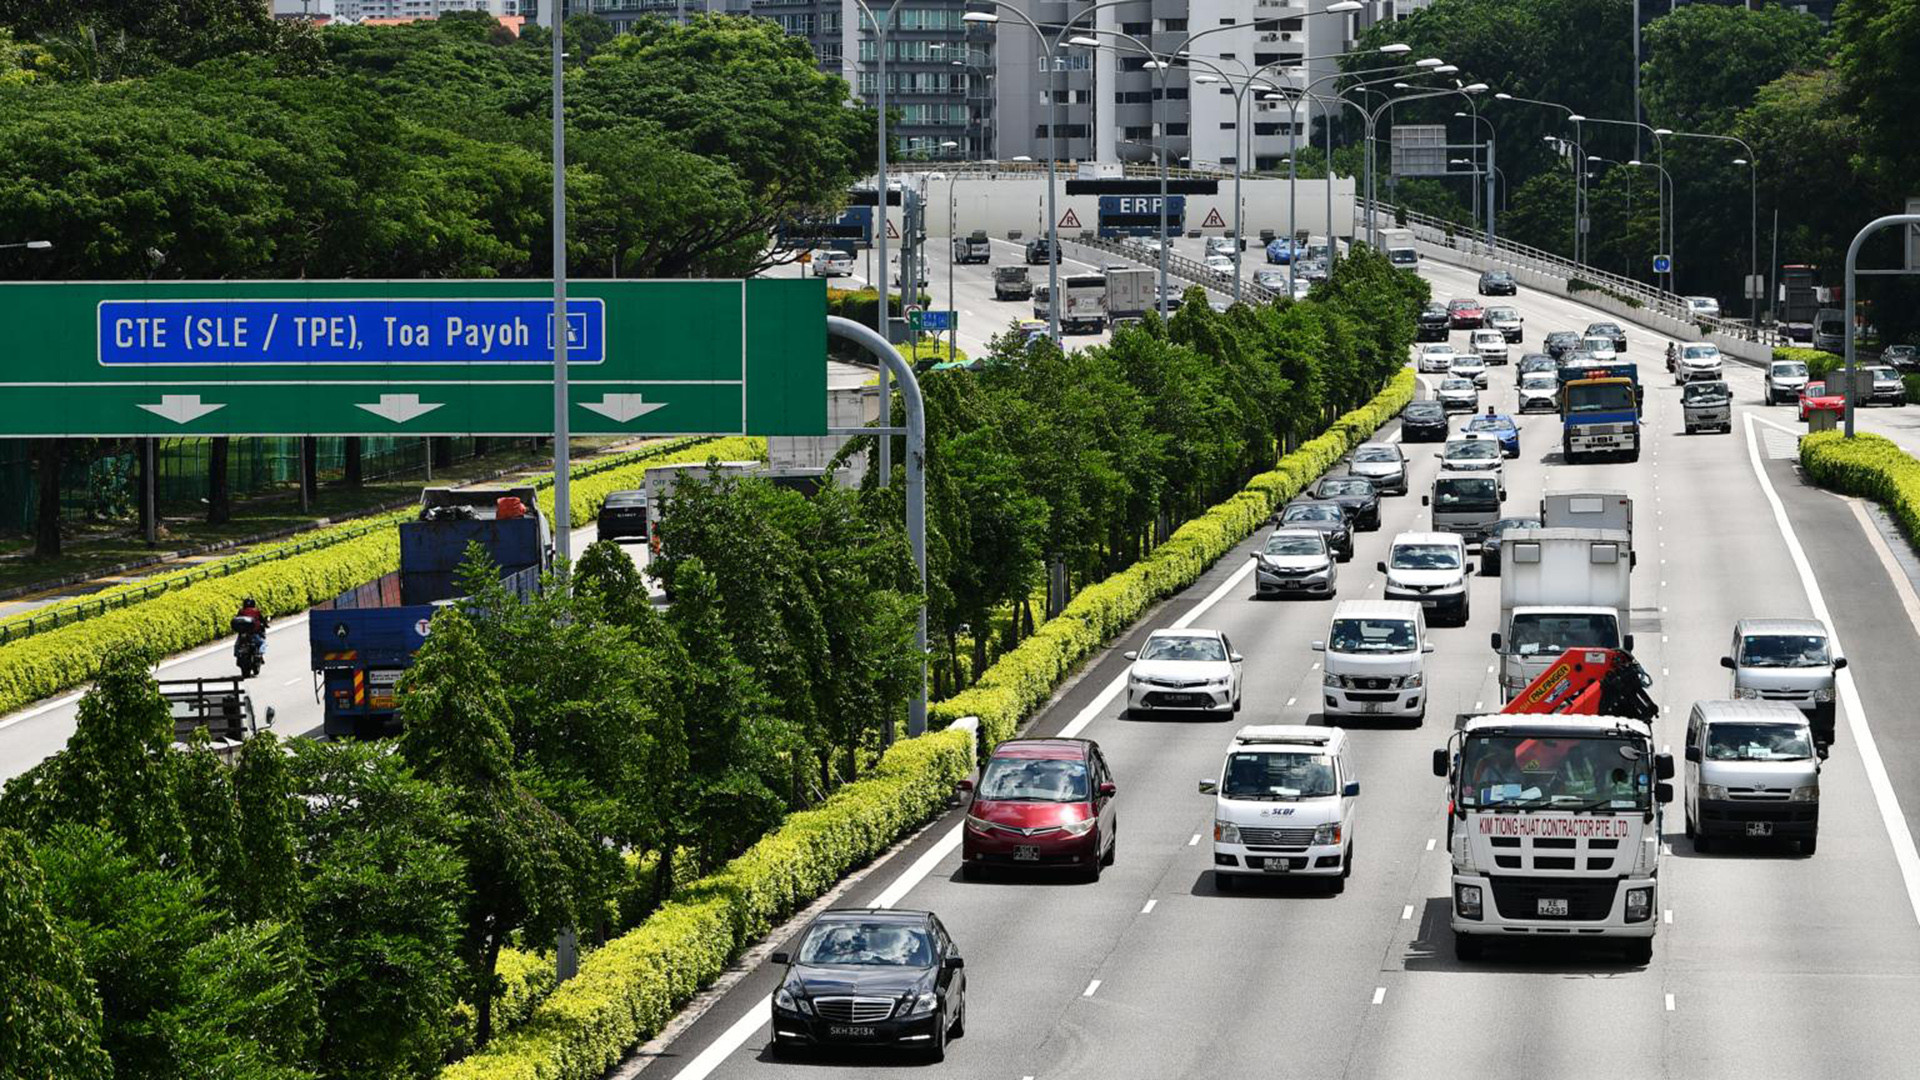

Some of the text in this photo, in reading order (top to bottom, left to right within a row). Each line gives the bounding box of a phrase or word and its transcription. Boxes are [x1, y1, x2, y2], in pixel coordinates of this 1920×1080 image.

[1120, 198, 1163, 214] ERP
[1066, 215, 1074, 225] R
[1210, 215, 1218, 225] R
[115, 313, 529, 354] CTE (SLE / TPE), Toa Payoh
[337, 624, 347, 636] A
[419, 621, 429, 634] T
[1530, 664, 1569, 702] PALFINGER
[1479, 817, 1630, 838] KIM TIONG HUAT CONTRACTOR PTE. LTD.
